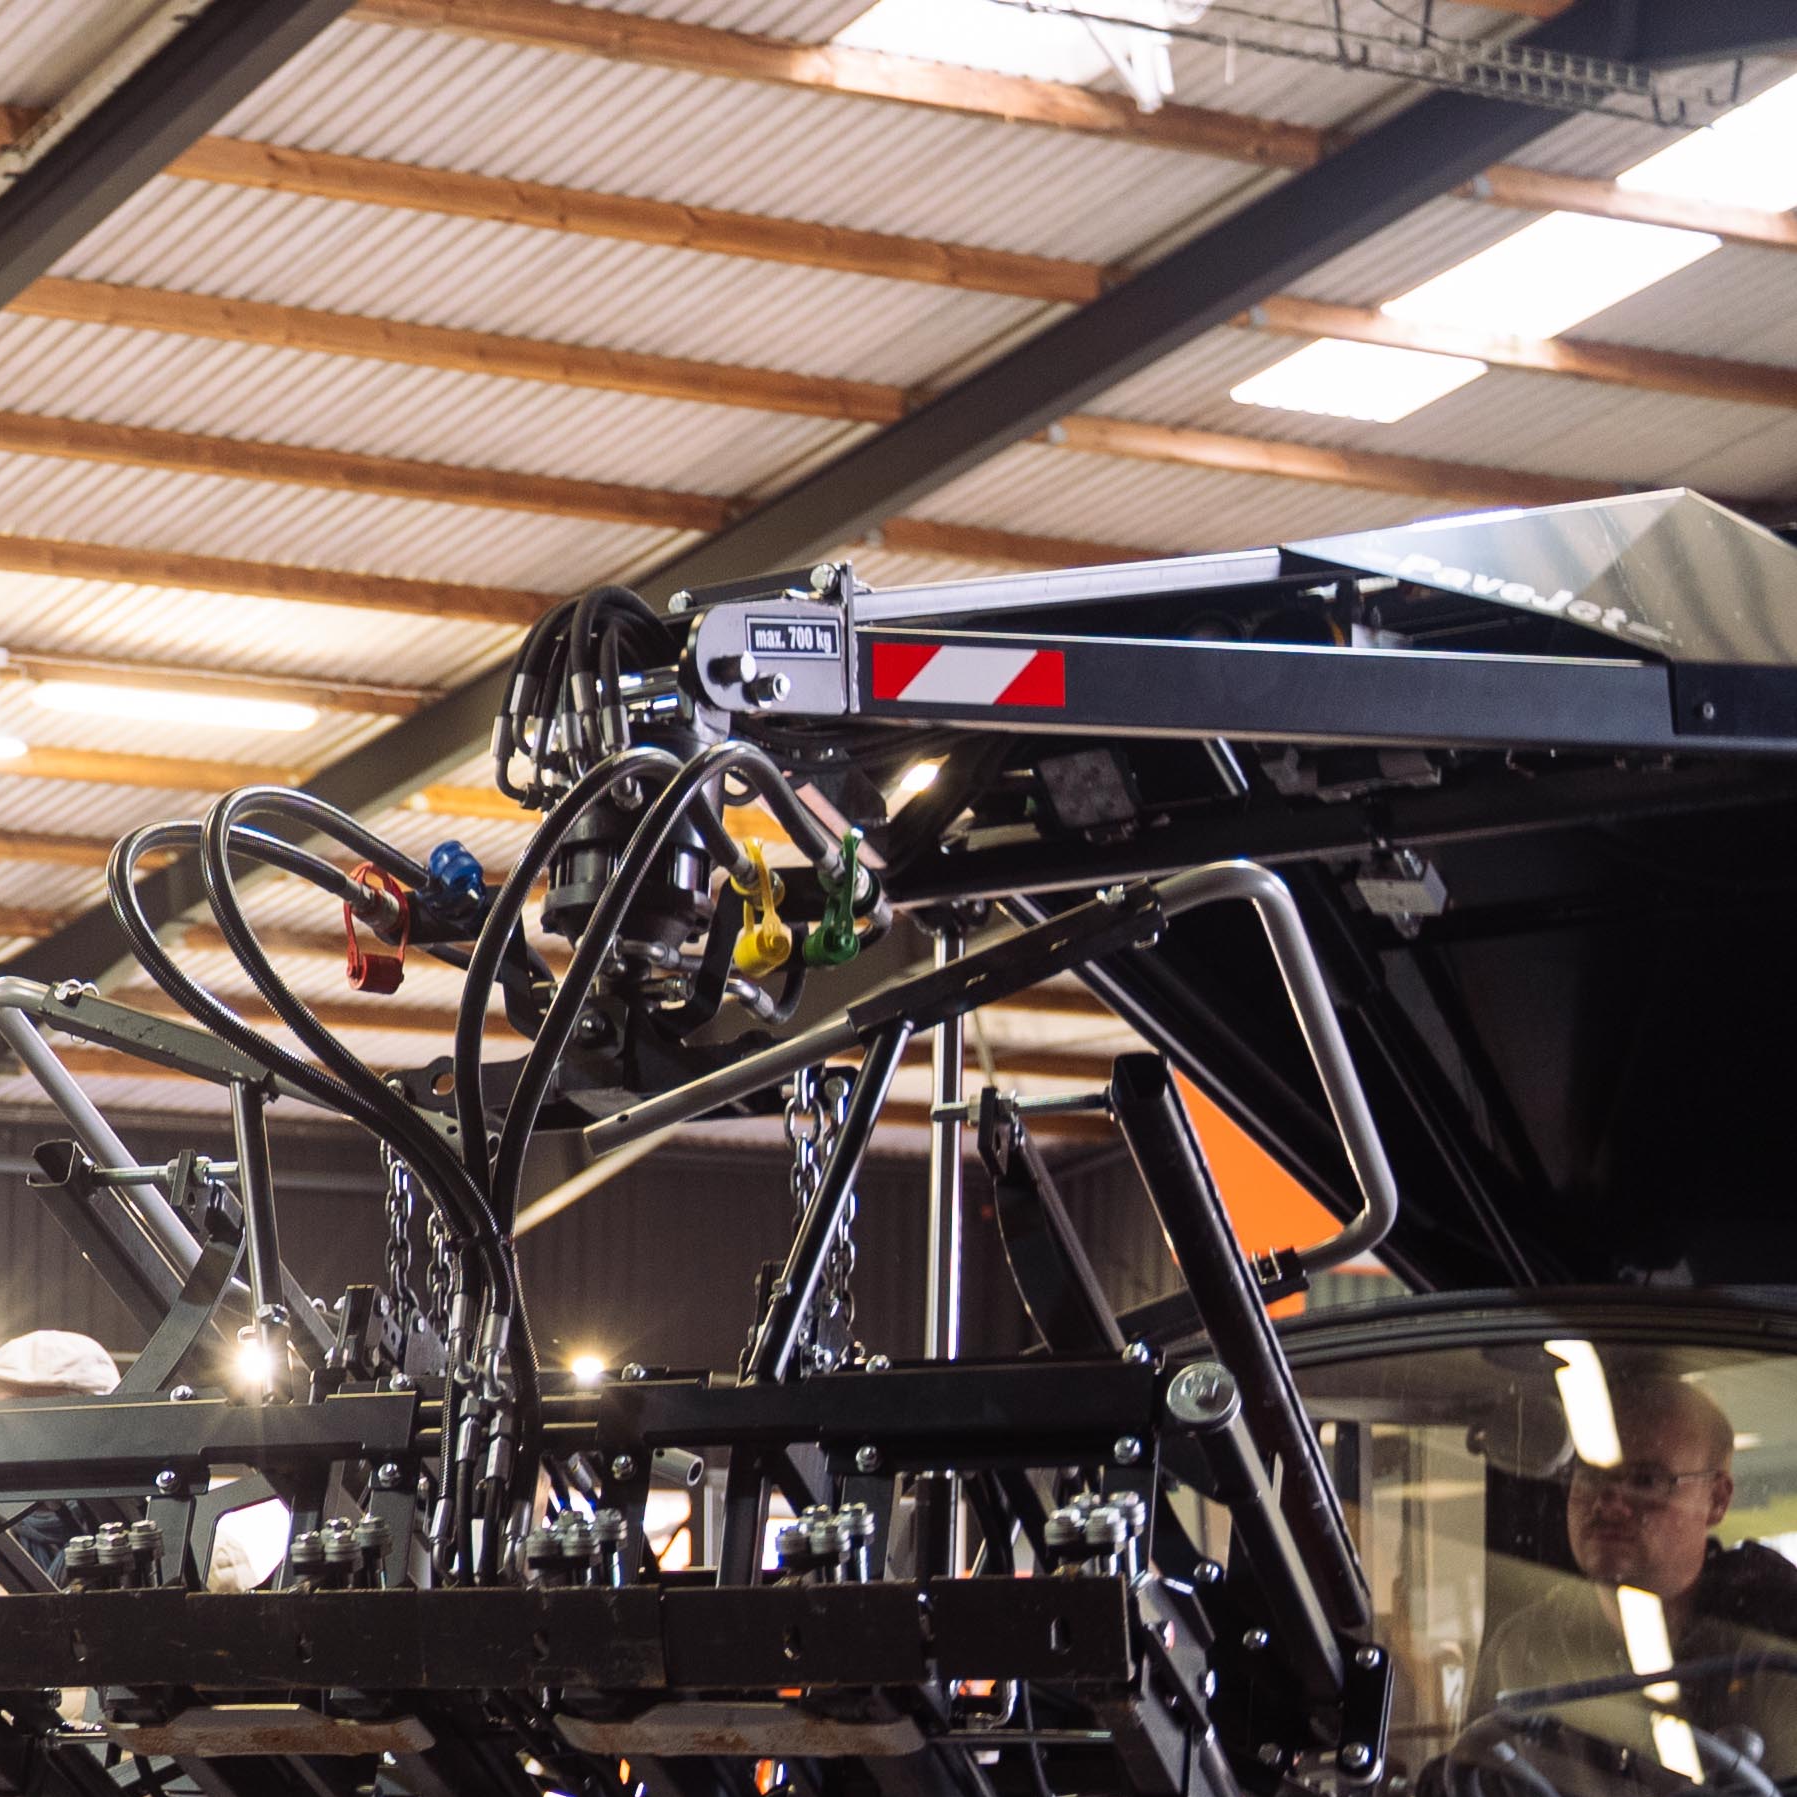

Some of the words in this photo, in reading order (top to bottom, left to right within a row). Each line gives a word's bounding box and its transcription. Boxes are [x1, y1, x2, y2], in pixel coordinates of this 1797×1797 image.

[754, 629, 785, 649] max.
[788, 626, 813, 650] 700
[816, 626, 832, 654] kg
